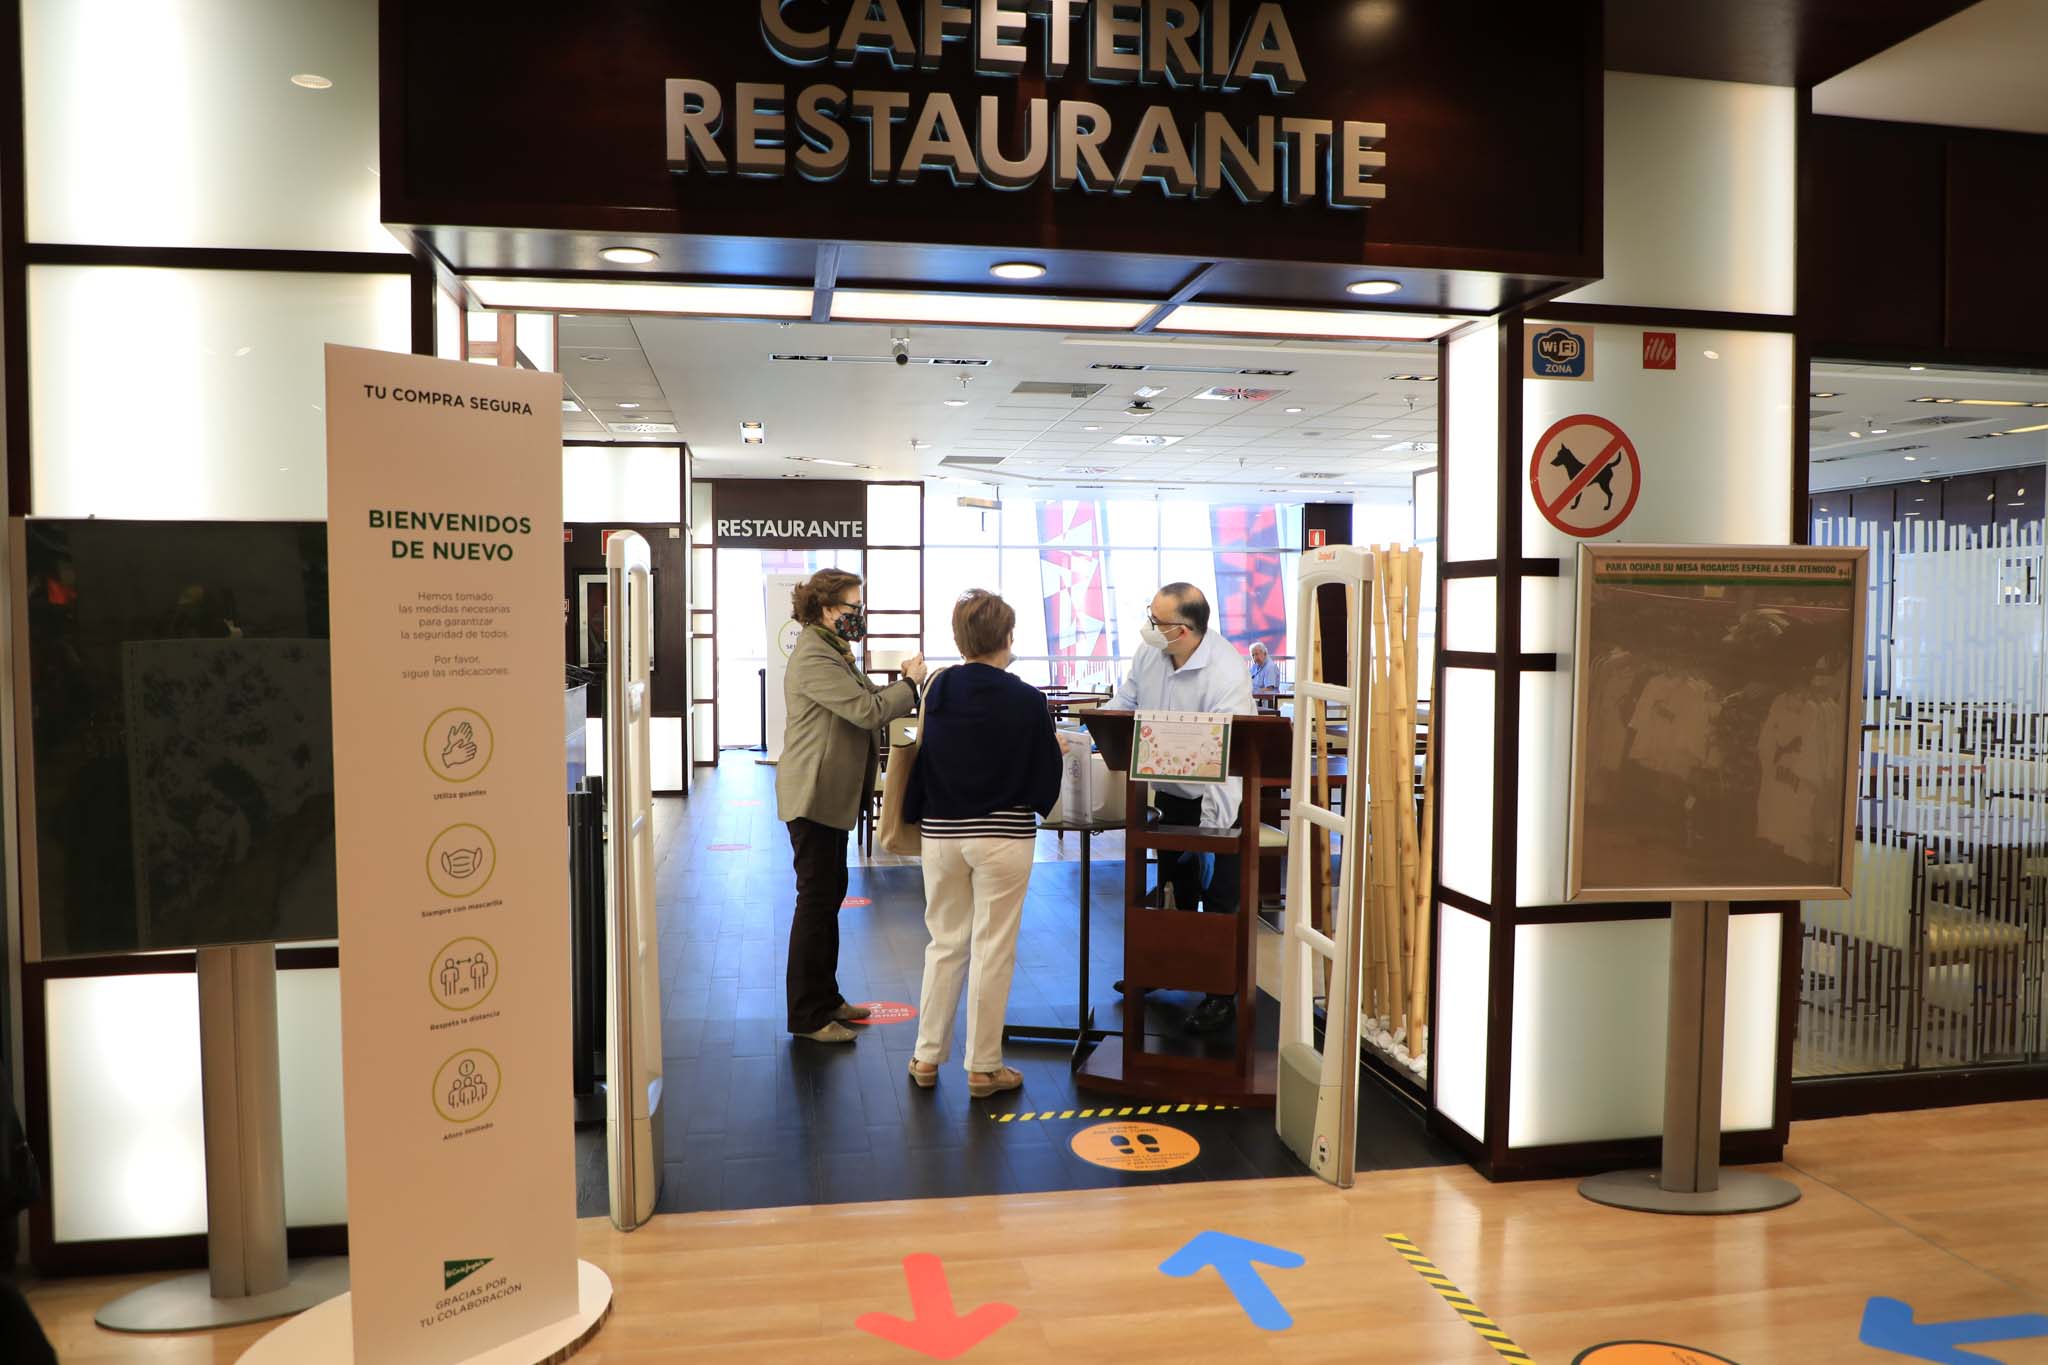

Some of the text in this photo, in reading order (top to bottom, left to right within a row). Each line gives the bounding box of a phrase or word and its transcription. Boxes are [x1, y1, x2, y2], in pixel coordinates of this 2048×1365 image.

[664, 77, 1388, 209] RESTAURANTE
[1644, 337, 1675, 366] illy
[1544, 364, 1572, 374] ZONA
[364, 384, 533, 415] TU COMPRA SEGURA
[368, 510, 532, 534] BIENVENIDOS
[718, 519, 862, 538] RESTAURANTE
[392, 541, 513, 561] DE NUEVO
[1606, 563, 1627, 571] PARA
[1630, 563, 1660, 572] OCUPAR
[1664, 563, 1673, 572] SU
[1675, 563, 1698, 573] MESA
[1700, 564, 1739, 573] ROGAMOS
[1742, 564, 1771, 573] ESPERE
[1773, 565, 1778, 573] A
[1781, 564, 1796, 573] SER
[1798, 565, 1836, 574] ATENDIDO
[418, 591, 493, 601] Hemos tomado
[399, 604, 511, 614] las medidas necesarias
[419, 616, 493, 628] para garantizar
[401, 630, 410, 639] la
[413, 630, 463, 641] seguridad
[466, 629, 477, 639] de
[434, 655, 451, 665] Por
[402, 668, 430, 679] sigue
[432, 668, 446, 677] las
[435, 1276, 507, 1310] GRACIAS POR
[420, 1315, 434, 1328] TU
